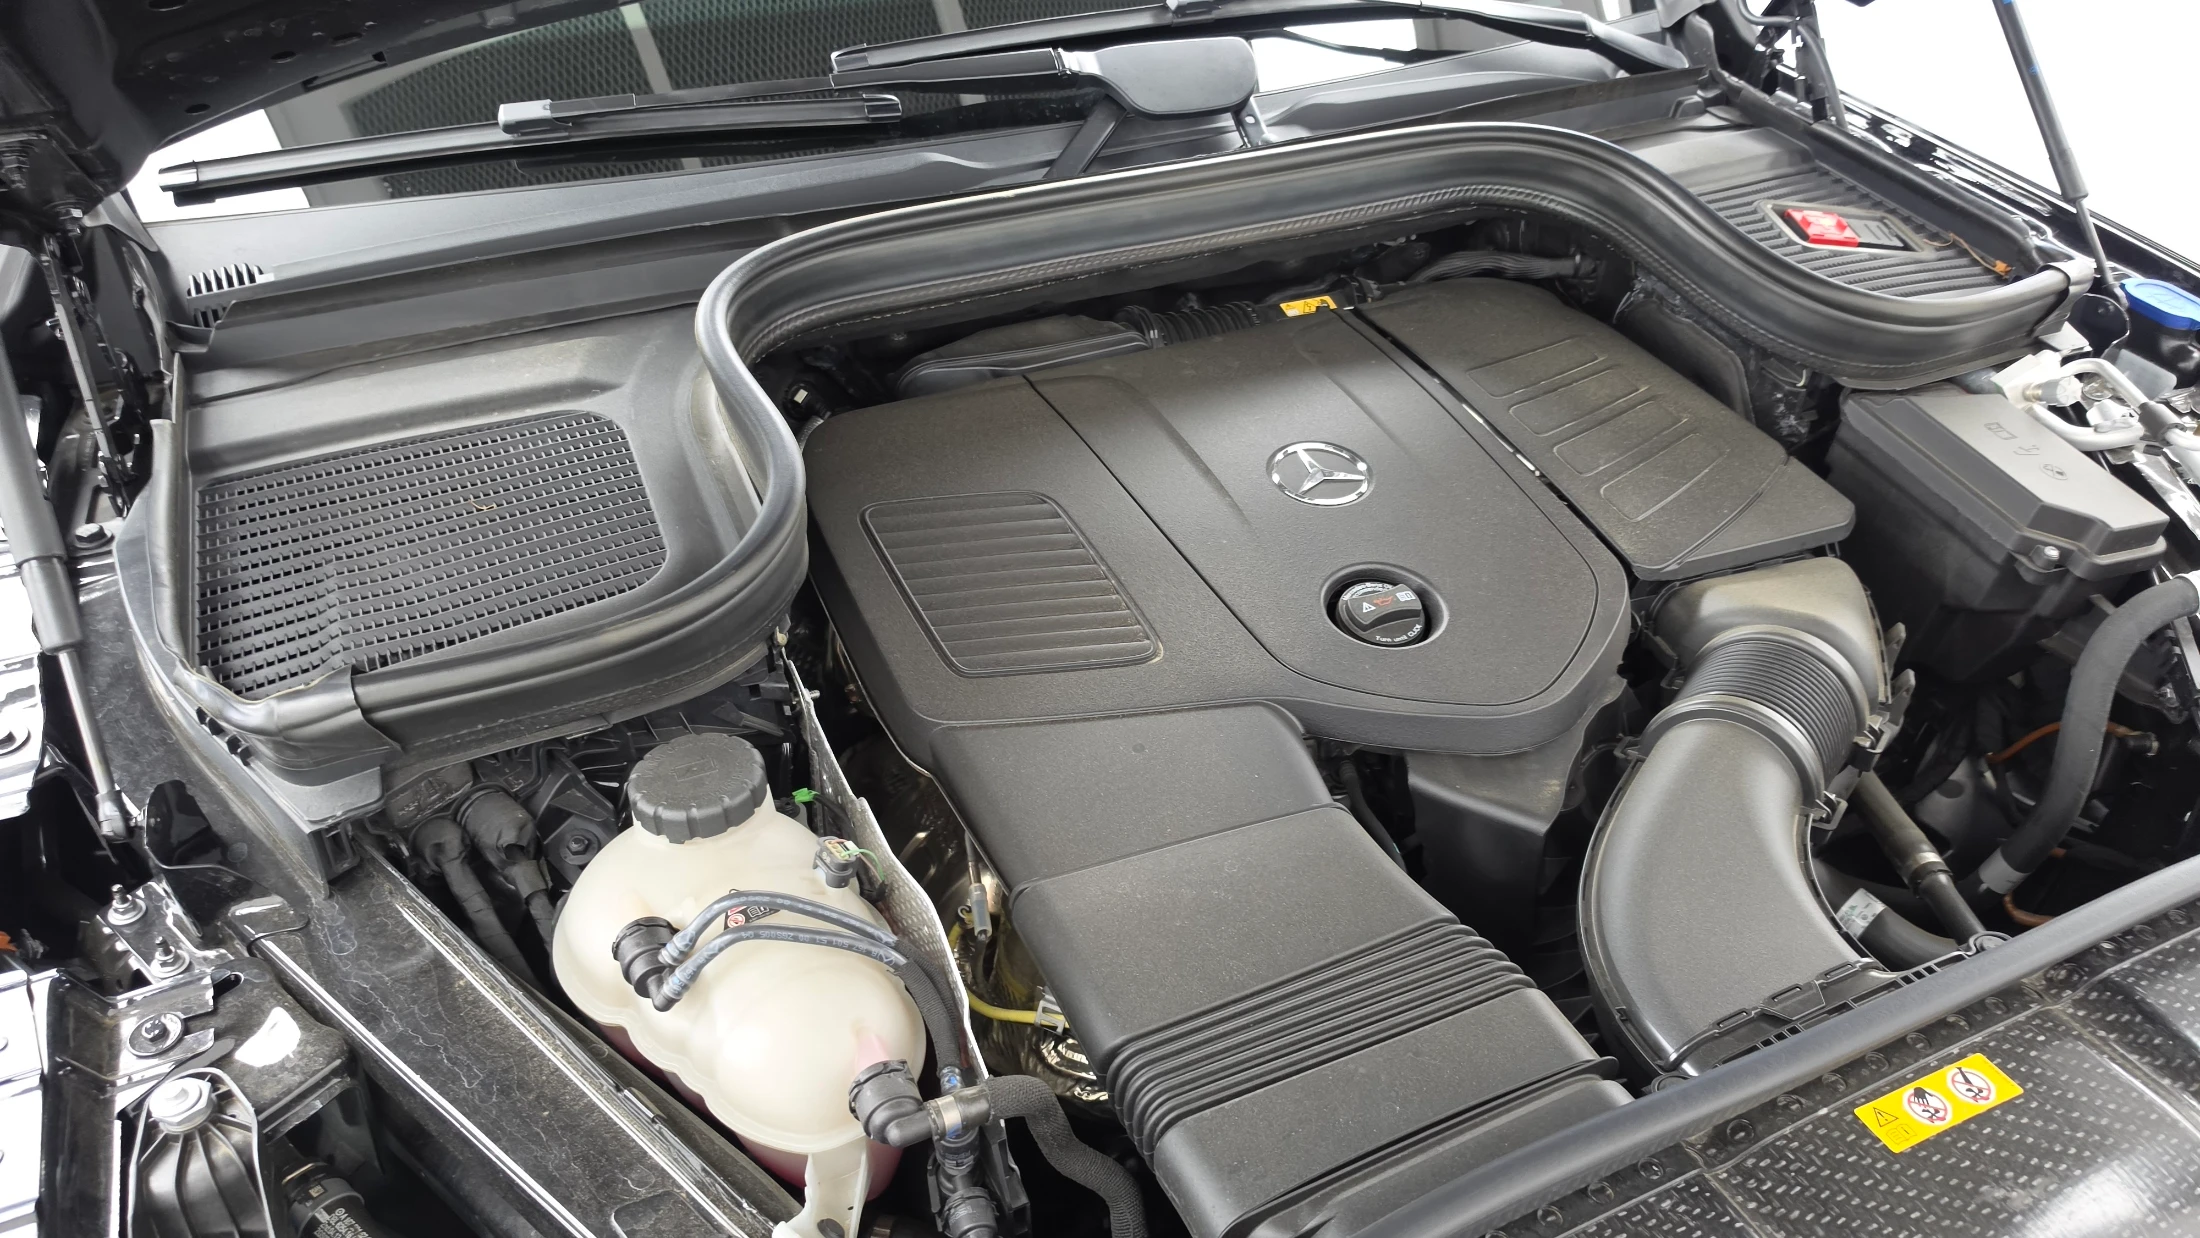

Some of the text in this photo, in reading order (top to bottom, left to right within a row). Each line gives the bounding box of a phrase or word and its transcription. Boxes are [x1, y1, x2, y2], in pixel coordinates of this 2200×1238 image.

[759, 930, 794, 940] ZGS005
[798, 934, 810, 942] 00
[815, 937, 828, 945] 51
[832, 938, 849, 948] 501
